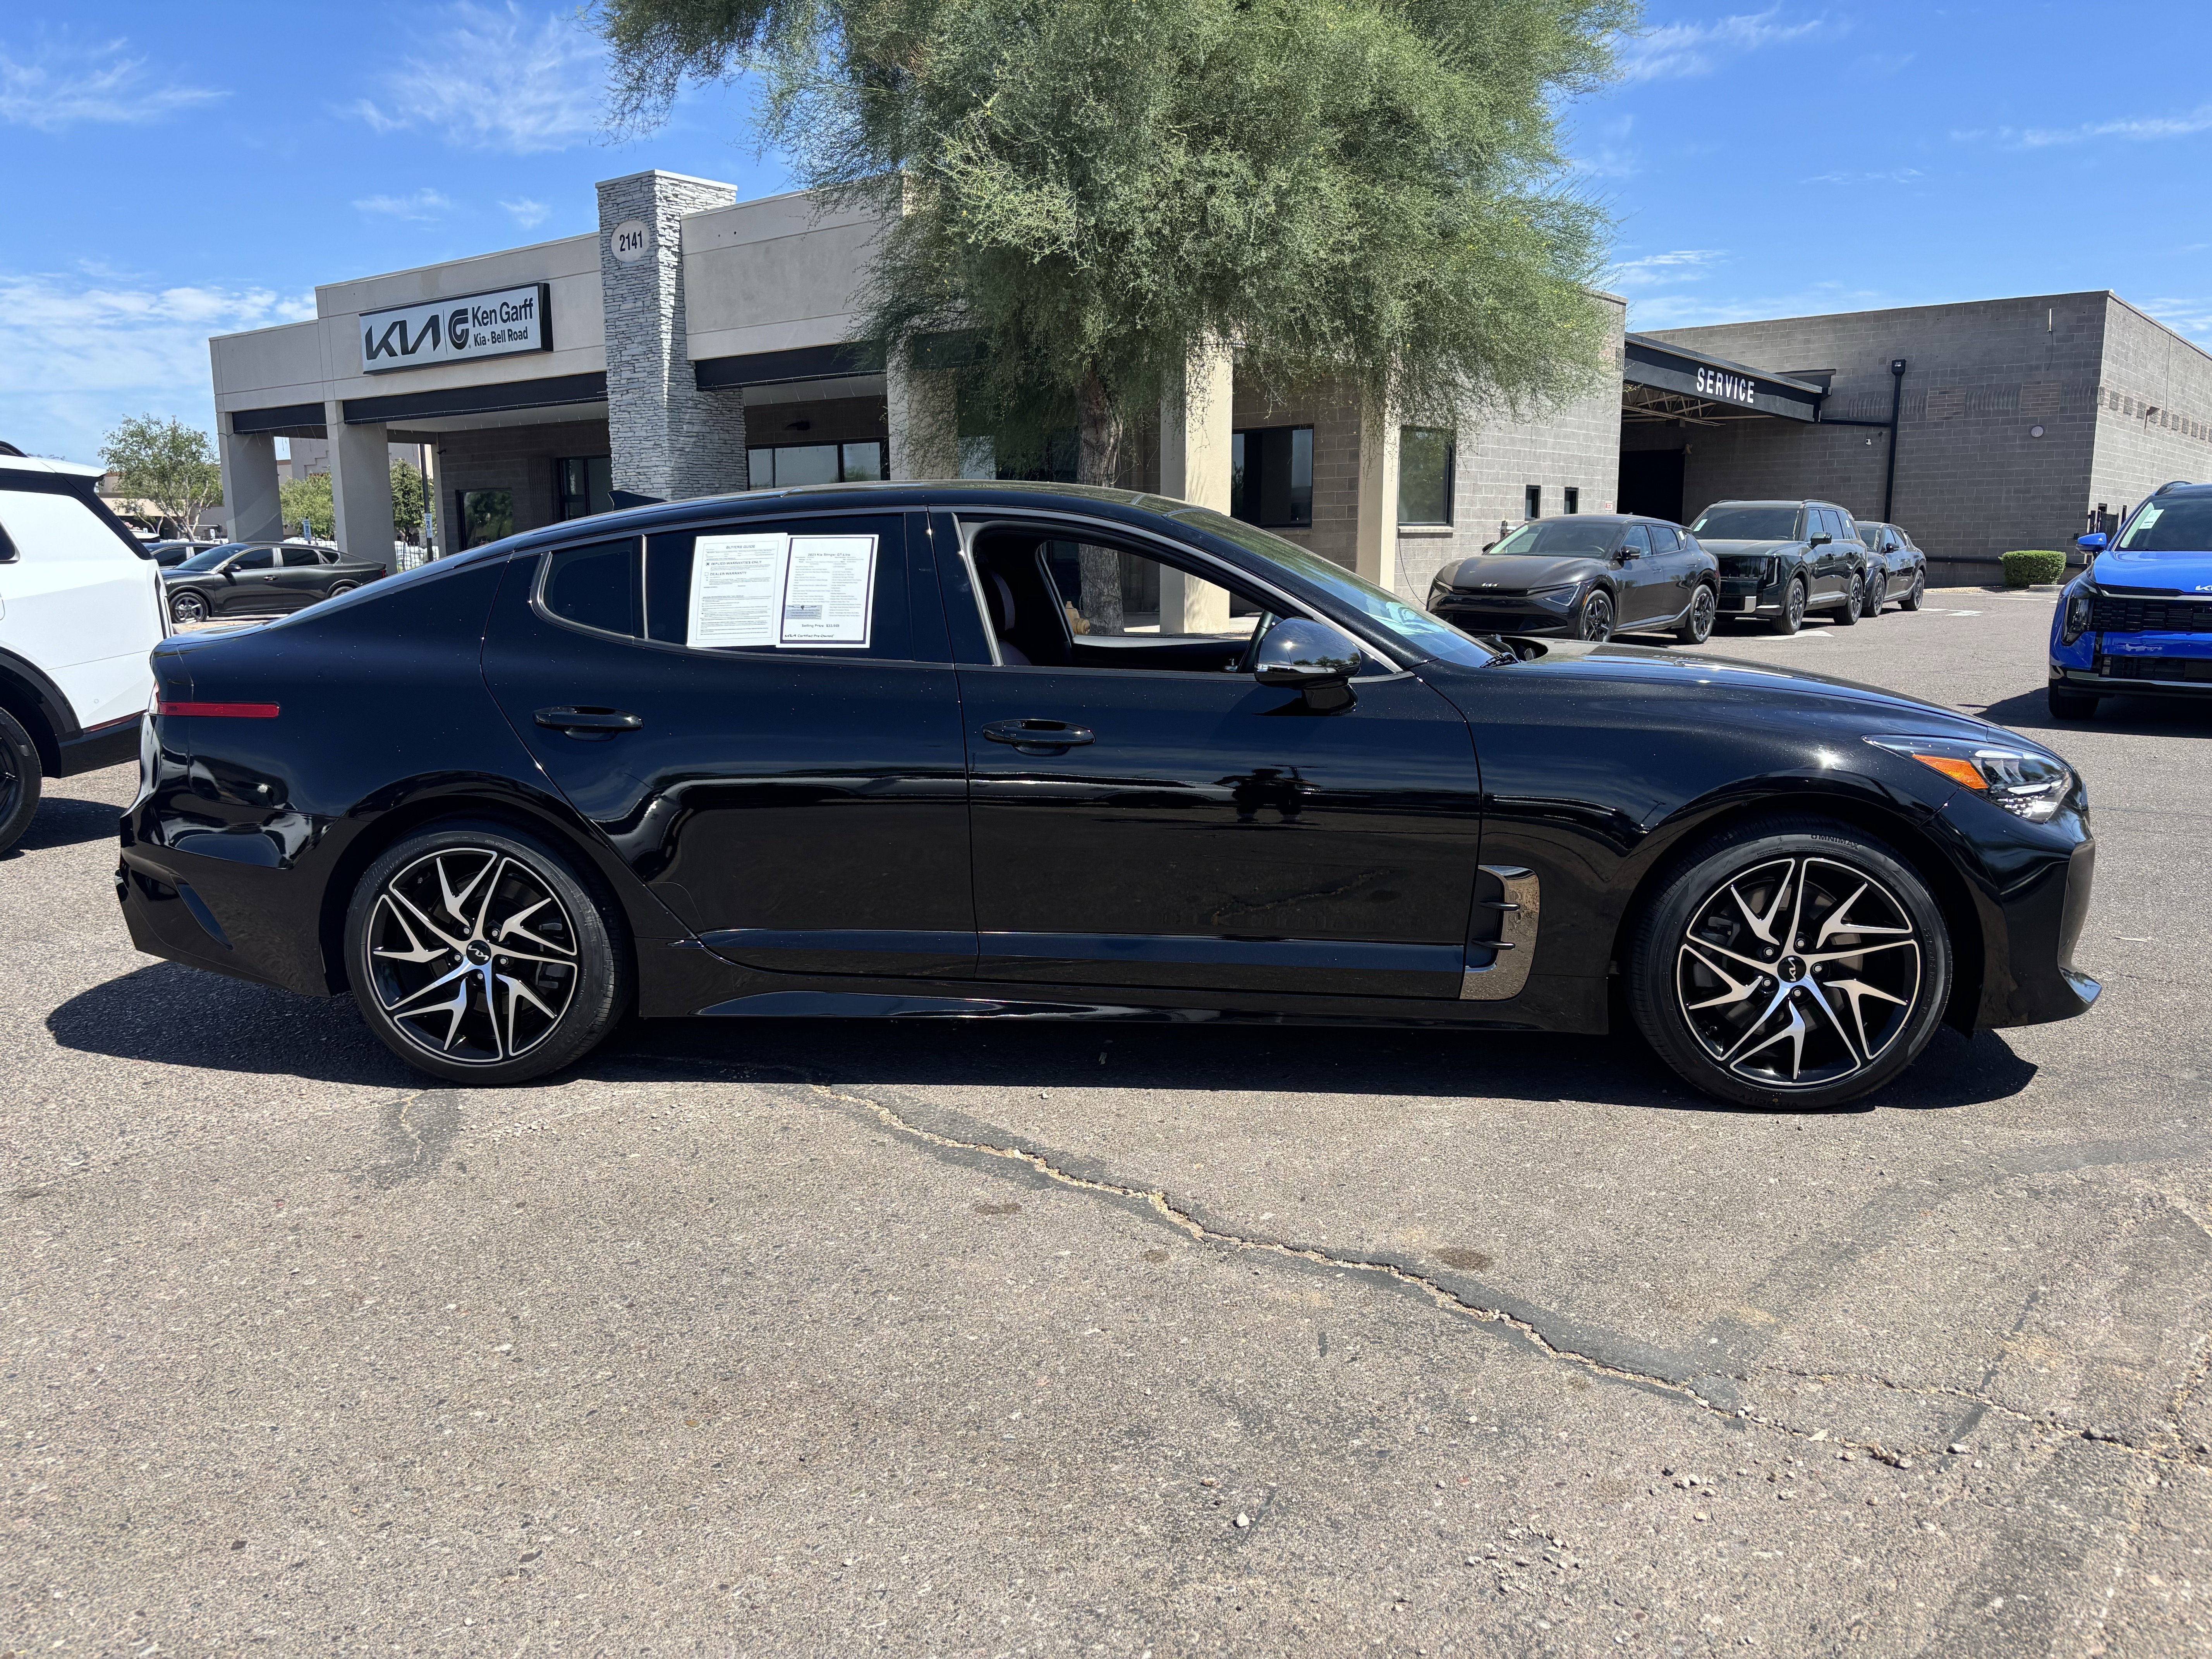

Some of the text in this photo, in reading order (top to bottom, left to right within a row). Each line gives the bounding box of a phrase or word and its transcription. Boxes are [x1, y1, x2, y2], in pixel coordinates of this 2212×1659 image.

[620, 230, 642, 252] 2141
[472, 297, 533, 328] Ken Garff
[365, 314, 441, 360] KIA
[474, 326, 528, 347] Kia Bell Road
[1697, 368, 1754, 403] SERVICE
[1811, 835, 1858, 850] OMNIMAX
